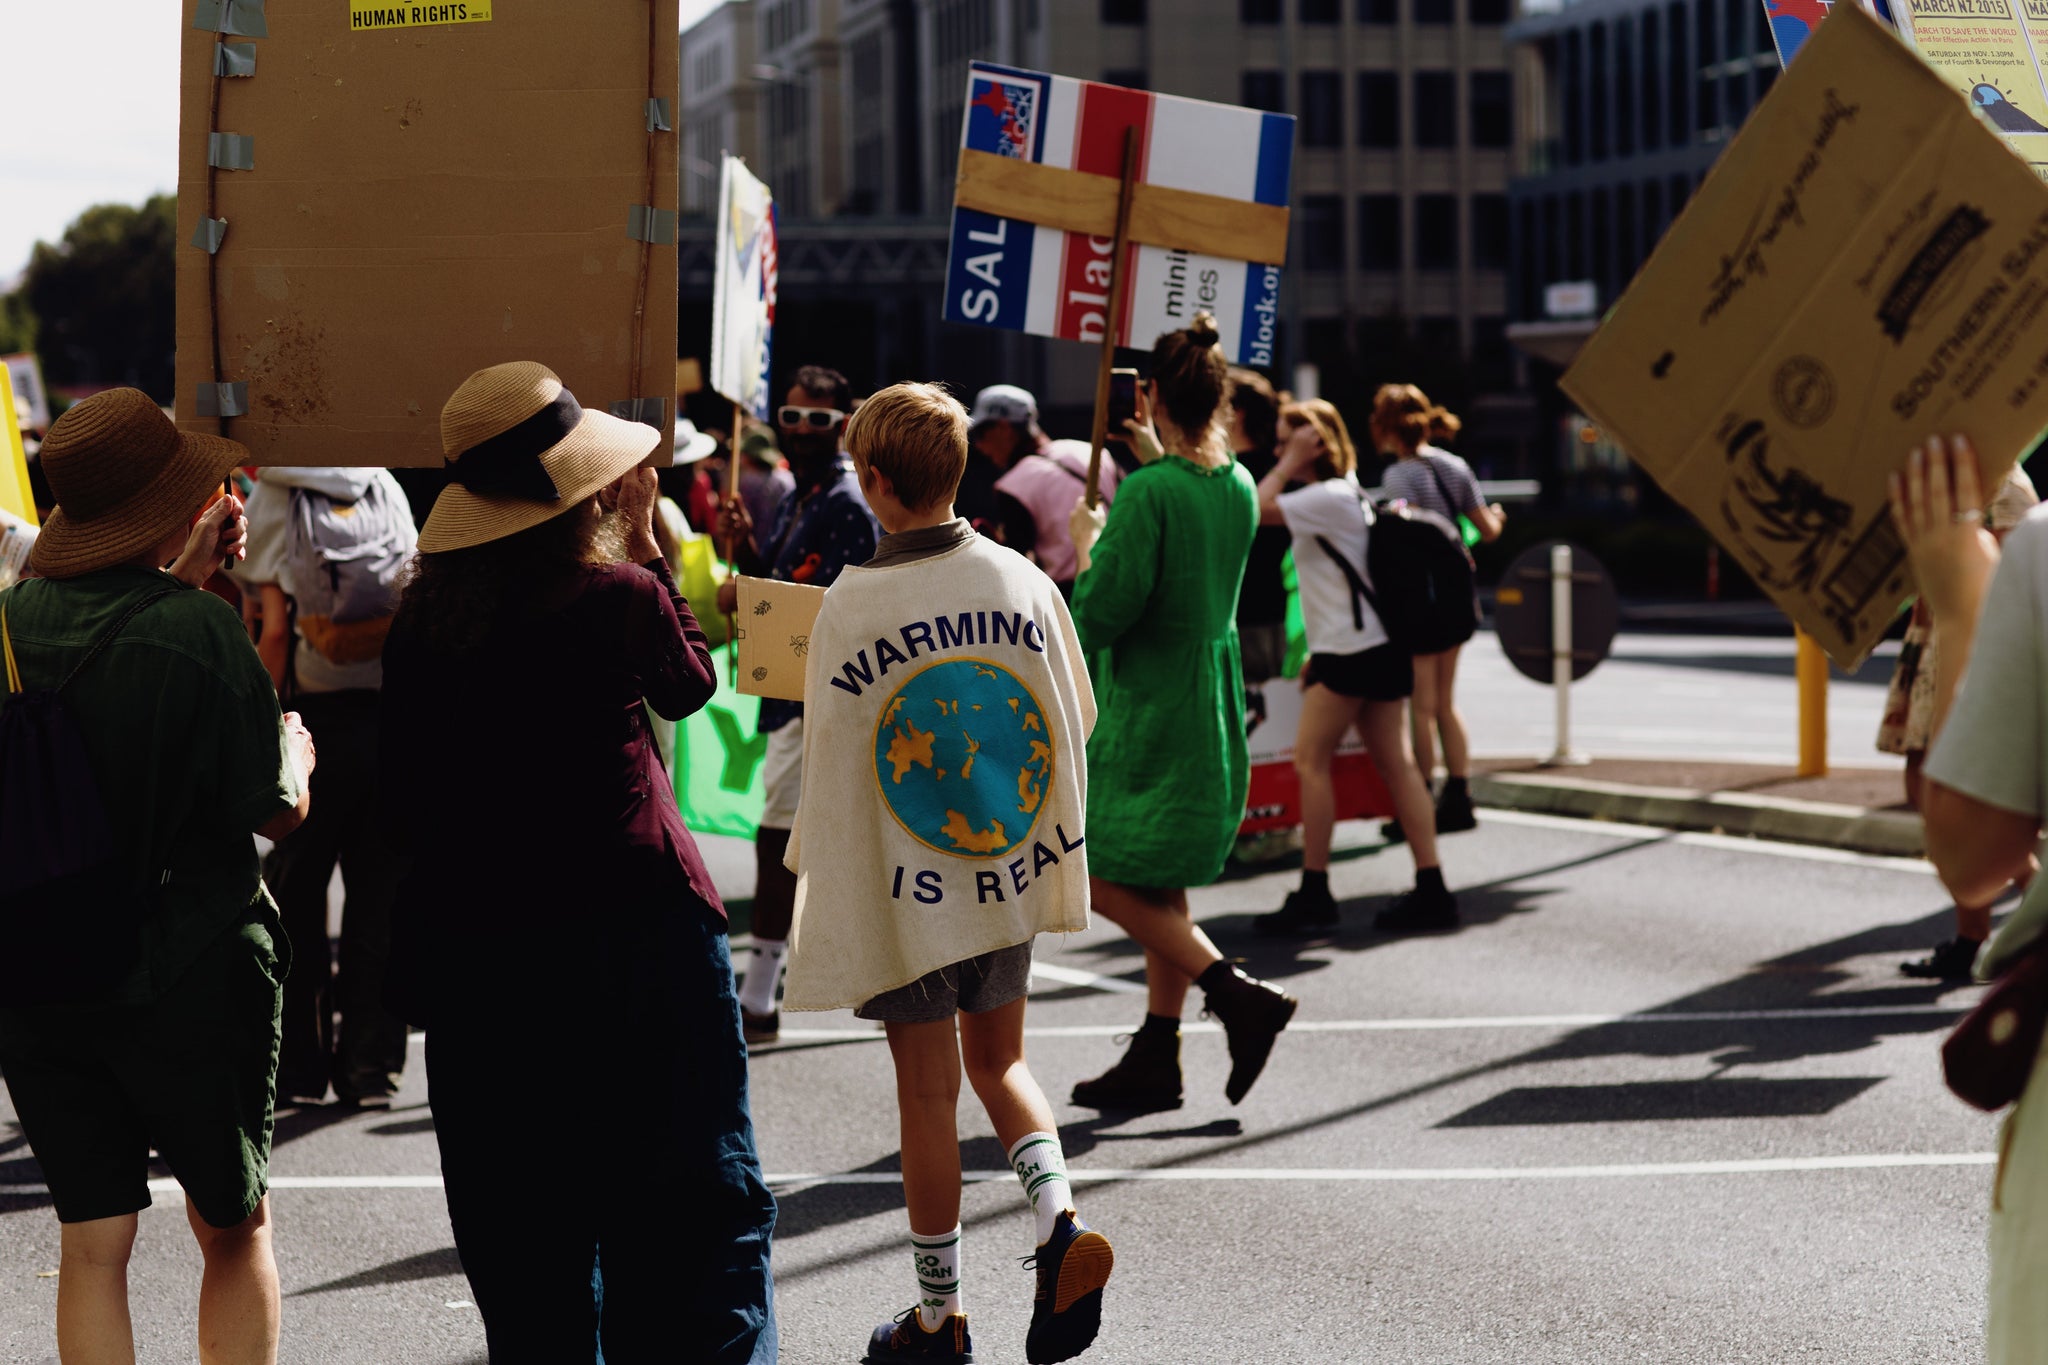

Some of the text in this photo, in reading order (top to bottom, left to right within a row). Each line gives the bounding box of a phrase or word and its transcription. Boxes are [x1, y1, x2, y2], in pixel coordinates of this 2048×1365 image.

[353, 3, 467, 27] HUMAN RIGHTS
[1910, 0, 2005, 14] MARCH NZ 2015
[1940, 27, 1951, 35] TO
[1952, 27, 1971, 35] SAVE
[1972, 27, 1989, 35] THE
[1989, 28, 2017, 36] WORLD
[1001, 86, 1017, 120] THE
[831, 611, 1045, 697] WARMING
[892, 823, 1084, 904] IS REAL
[914, 1252, 940, 1267] GO
